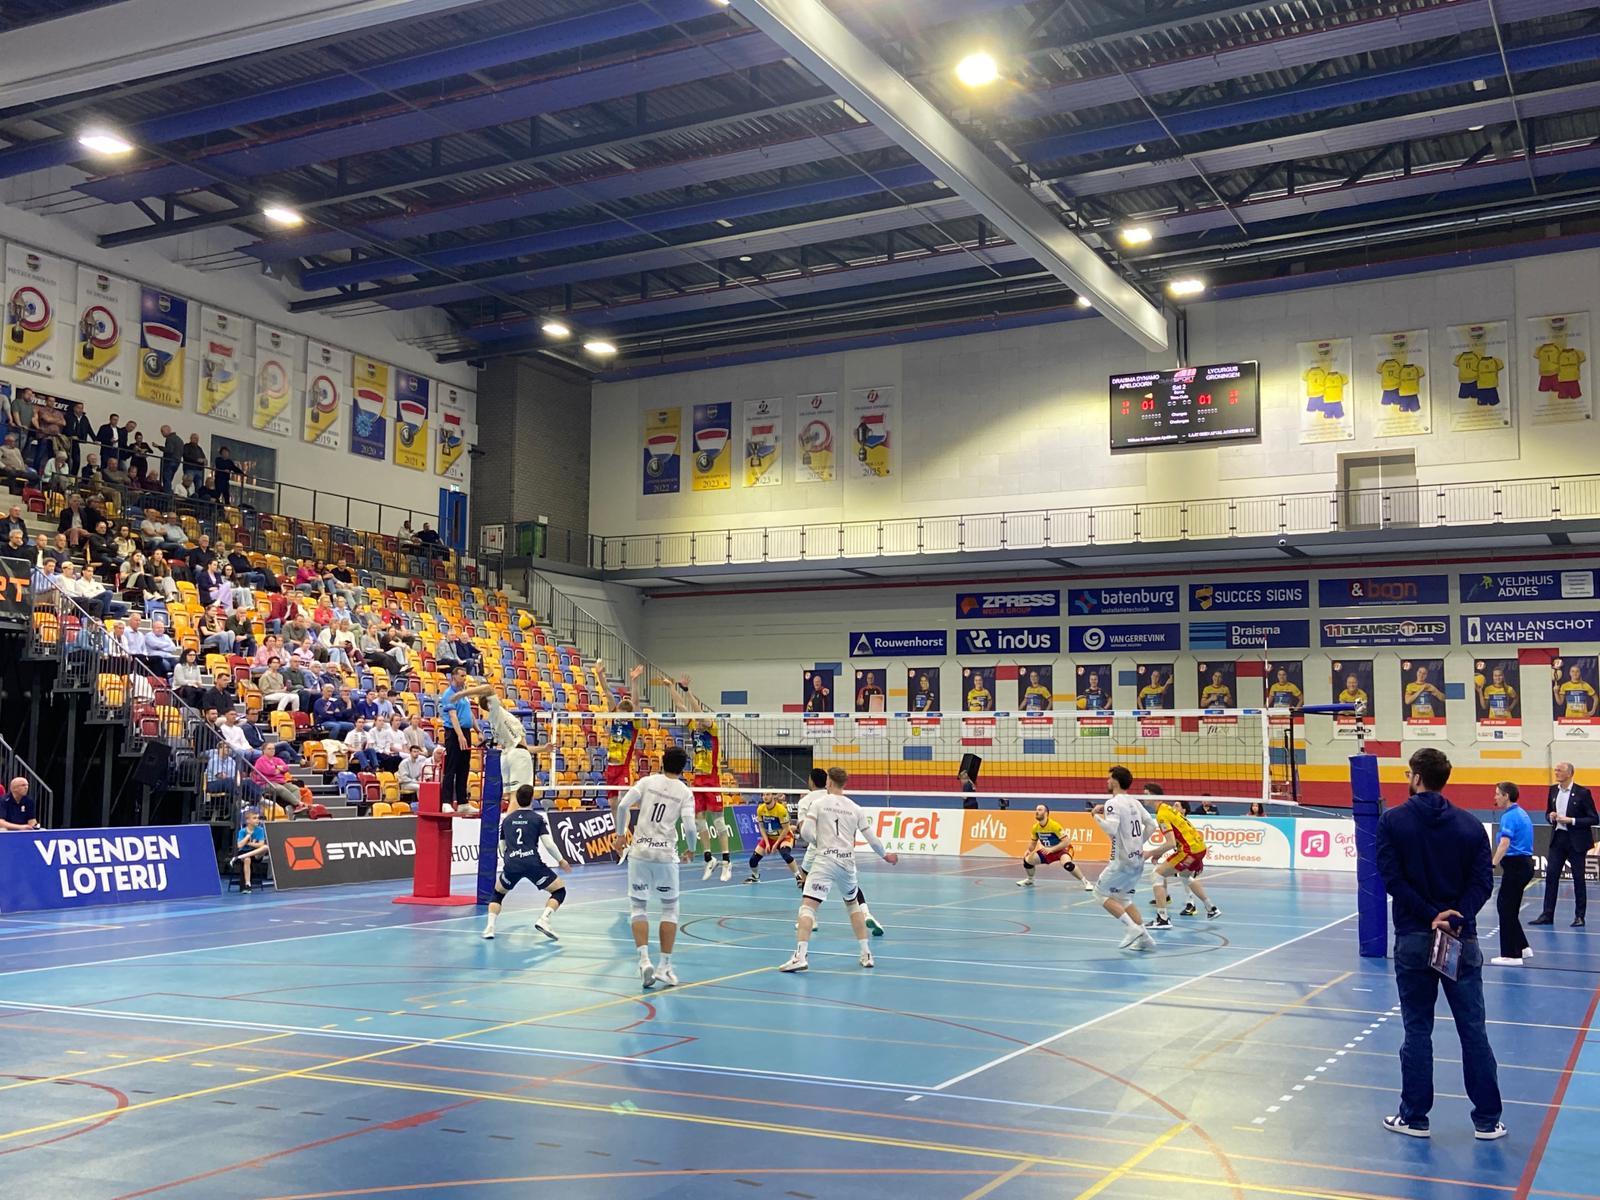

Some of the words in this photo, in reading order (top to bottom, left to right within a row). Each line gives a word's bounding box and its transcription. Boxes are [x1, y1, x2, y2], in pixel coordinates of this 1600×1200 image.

[17, 355, 41, 370] 2009
[1207, 366, 1239, 374] LYCURGUS
[88, 371, 110, 385] 2010
[1205, 372, 1240, 381] GRONINGEN
[150, 389, 171, 403] 2010
[1199, 395, 1212, 405] 01
[1141, 400, 1154, 410] 01
[360, 444, 377, 455] 2020
[404, 455, 419, 466] 2021
[1497, 575, 1554, 587] VELDHUIS
[1101, 588, 1174, 606] batenburg
[1215, 590, 1261, 603] SUCCES
[1266, 588, 1303, 602] SIGNS
[1498, 586, 1539, 597] ADVIES
[983, 594, 1056, 608] ZPRESS
[1232, 625, 1280, 635] Draisma
[1485, 621, 1513, 631] VAN
[1518, 620, 1594, 630] LANSCHOT
[874, 636, 944, 648] Rouwenhorst
[998, 630, 1051, 649] indus
[1232, 636, 1265, 645] Bouw
[1486, 631, 1544, 642] KEMPEN
[651, 803, 666, 823] 10
[834, 818, 839, 836] 1
[1131, 819, 1142, 838] 20
[515, 827, 524, 845] 2
[34, 835, 180, 866] VRIENDEN
[326, 839, 417, 861] STANNO
[885, 842, 939, 852] AKERY
[1214, 853, 1262, 863] shortlease
[59, 863, 168, 898] LOTERIJ
